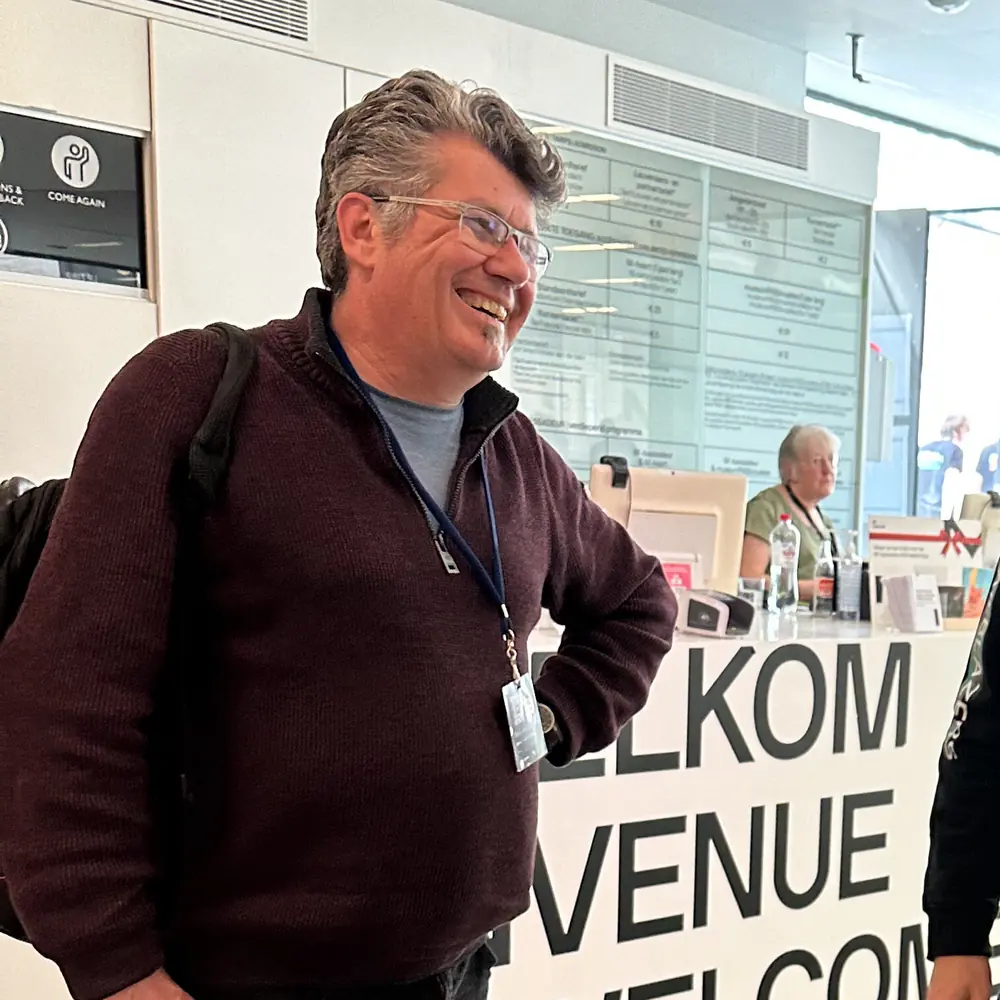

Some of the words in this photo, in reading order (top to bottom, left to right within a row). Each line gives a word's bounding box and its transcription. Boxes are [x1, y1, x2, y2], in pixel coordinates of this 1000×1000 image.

[47, 191, 75, 203] COME
[76, 196, 105, 208] AGAIN
[487, 789, 894, 967] VENUE
